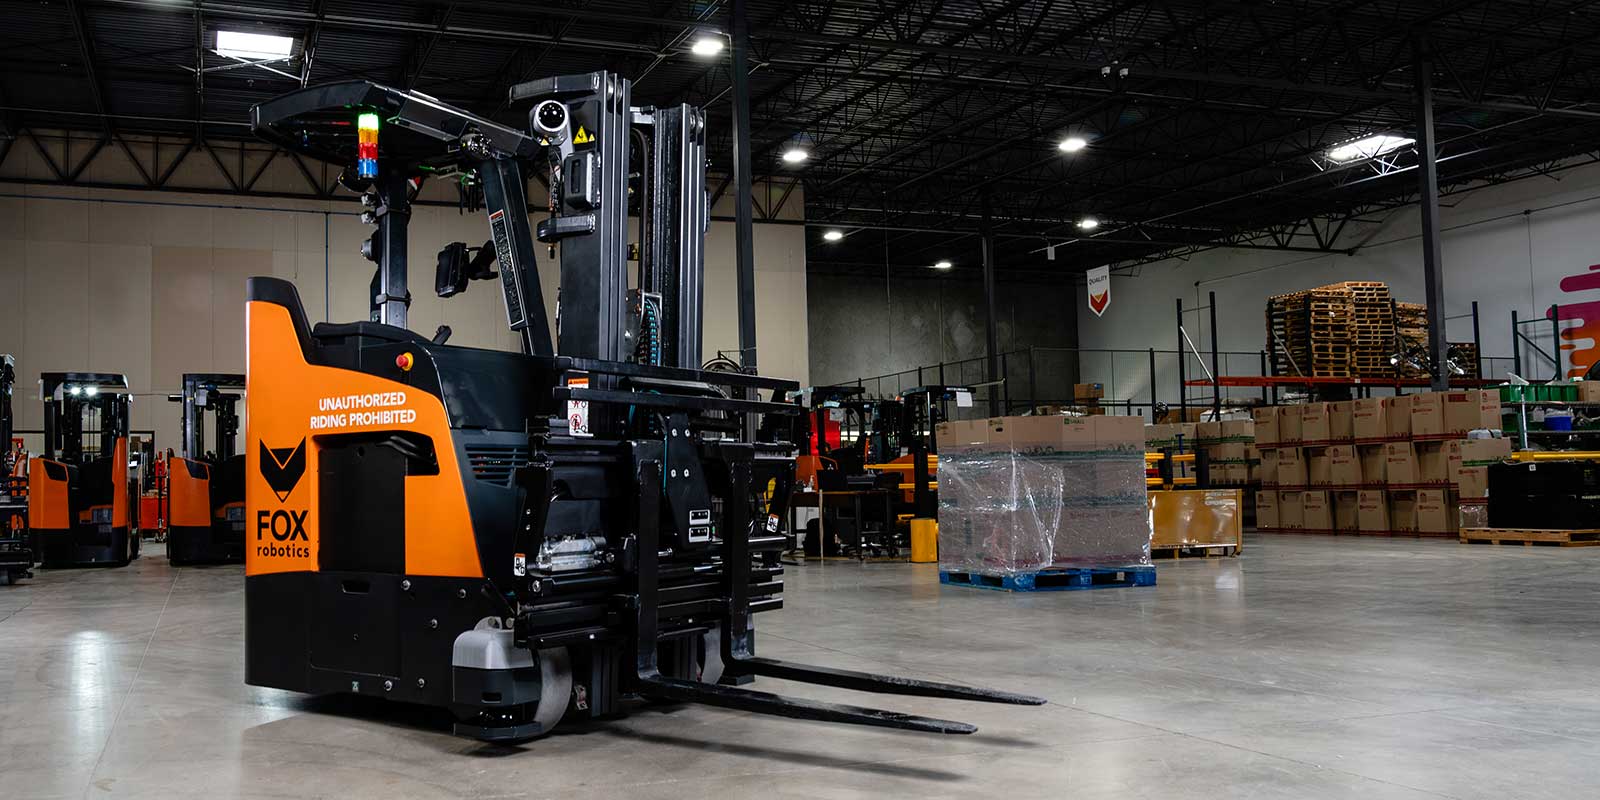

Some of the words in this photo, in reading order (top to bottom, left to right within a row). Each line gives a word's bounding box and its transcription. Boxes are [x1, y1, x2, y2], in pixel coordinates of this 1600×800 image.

[319, 392, 406, 411] UNAUTHORIZED
[310, 415, 347, 429] RIDING
[349, 409, 416, 426] PROHIBITED
[257, 510, 309, 541] FOX
[257, 543, 310, 558] robotics
